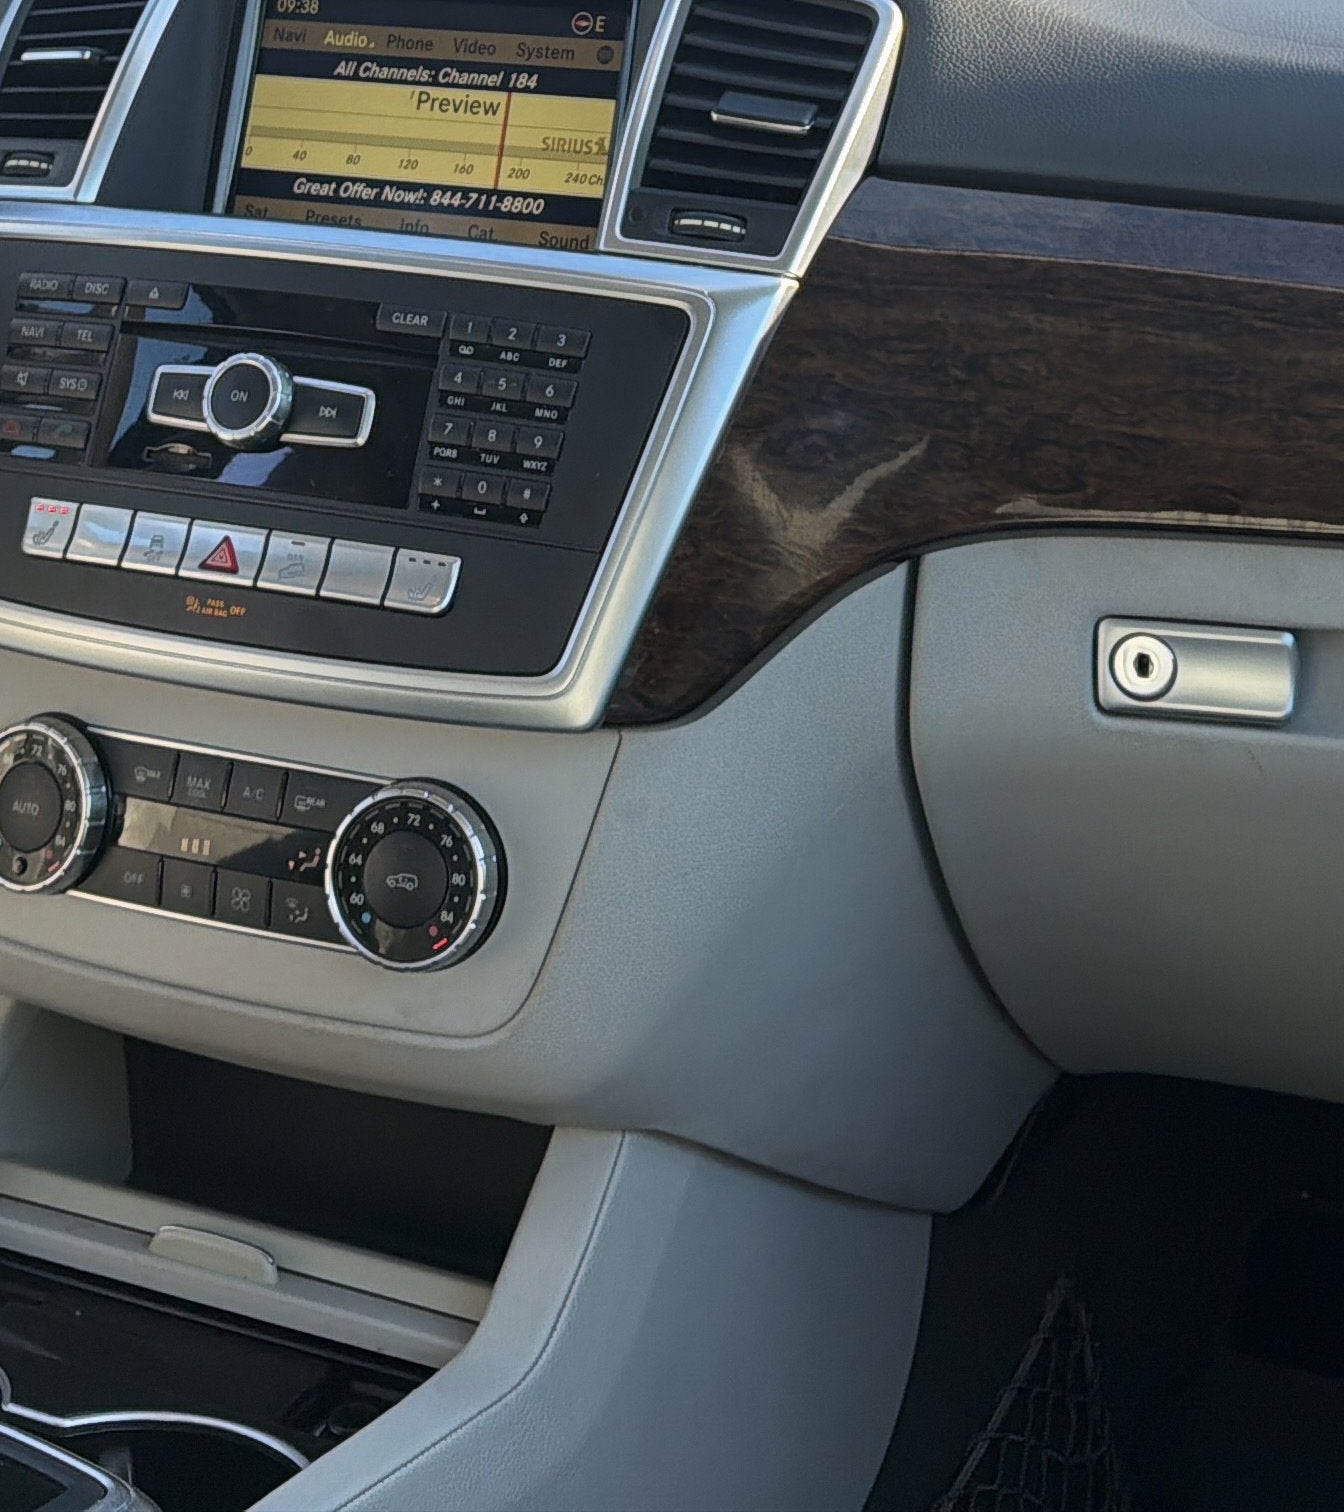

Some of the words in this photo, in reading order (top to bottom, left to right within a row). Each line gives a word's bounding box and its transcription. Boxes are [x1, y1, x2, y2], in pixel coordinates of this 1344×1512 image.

[595, 16, 606, 32] E
[273, 27, 307, 43] Navi
[323, 30, 368, 48] Audio
[386, 34, 434, 51] Phone
[452, 37, 497, 56] Video
[516, 42, 575, 61] System
[333, 60, 357, 76] All
[358, 61, 435, 83] Channels:
[438, 67, 505, 87] Channel
[508, 72, 539, 89] 184
[416, 90, 501, 116] Preview
[541, 136, 593, 155] SIRIUS
[245, 146, 253, 156] 0
[292, 150, 307, 161] 40
[345, 154, 361, 165] 80
[398, 158, 419, 170] 120
[454, 163, 474, 175] 160
[507, 167, 530, 180] 200
[564, 172, 587, 185] 240
[292, 177, 337, 196] Great
[339, 181, 379, 200] Offer
[429, 189, 545, 215] 844-711-8800
[306, 208, 363, 227] Presets
[538, 230, 591, 250] Sound
[29, 279, 59, 291] RADIO
[84, 282, 110, 295] DISC
[391, 312, 429, 327] CLEAR
[20, 326, 44, 338] NAVI
[466, 321, 473, 333] 1
[507, 327, 518, 340] 2
[76, 329, 94, 342] TEL
[556, 334, 567, 347] 3
[499, 350, 521, 362] ABC
[548, 357, 569, 369] DEF
[453, 372, 463, 384] 4
[497, 377, 507, 390] 5
[230, 389, 249, 403] ON
[544, 385, 555, 398] 6
[446, 395, 466, 407] GHI
[490, 402, 508, 413] JKL
[534, 407, 559, 420] MNO
[443, 422, 454, 435] 7
[487, 429, 497, 442] 8
[533, 435, 544, 448] 9
[433, 446, 458, 459] PQRS
[480, 453, 500, 465] TUV
[522, 458, 549, 471] WXYZ
[477, 481, 487, 494] 0
[206, 598, 225, 608] PASS
[229, 605, 248, 616] OFF
[187, 775, 211, 790] MAX
[243, 787, 265, 801] A/C
[12, 800, 40, 816] AUTO
[407, 813, 421, 827] 72
[370, 821, 385, 835] 68
[440, 834, 453, 848] 76
[348, 854, 363, 866] 64
[123, 872, 144, 884] OFF
[451, 874, 466, 887] 80
[349, 893, 365, 906] 60
[440, 910, 454, 923] 84
